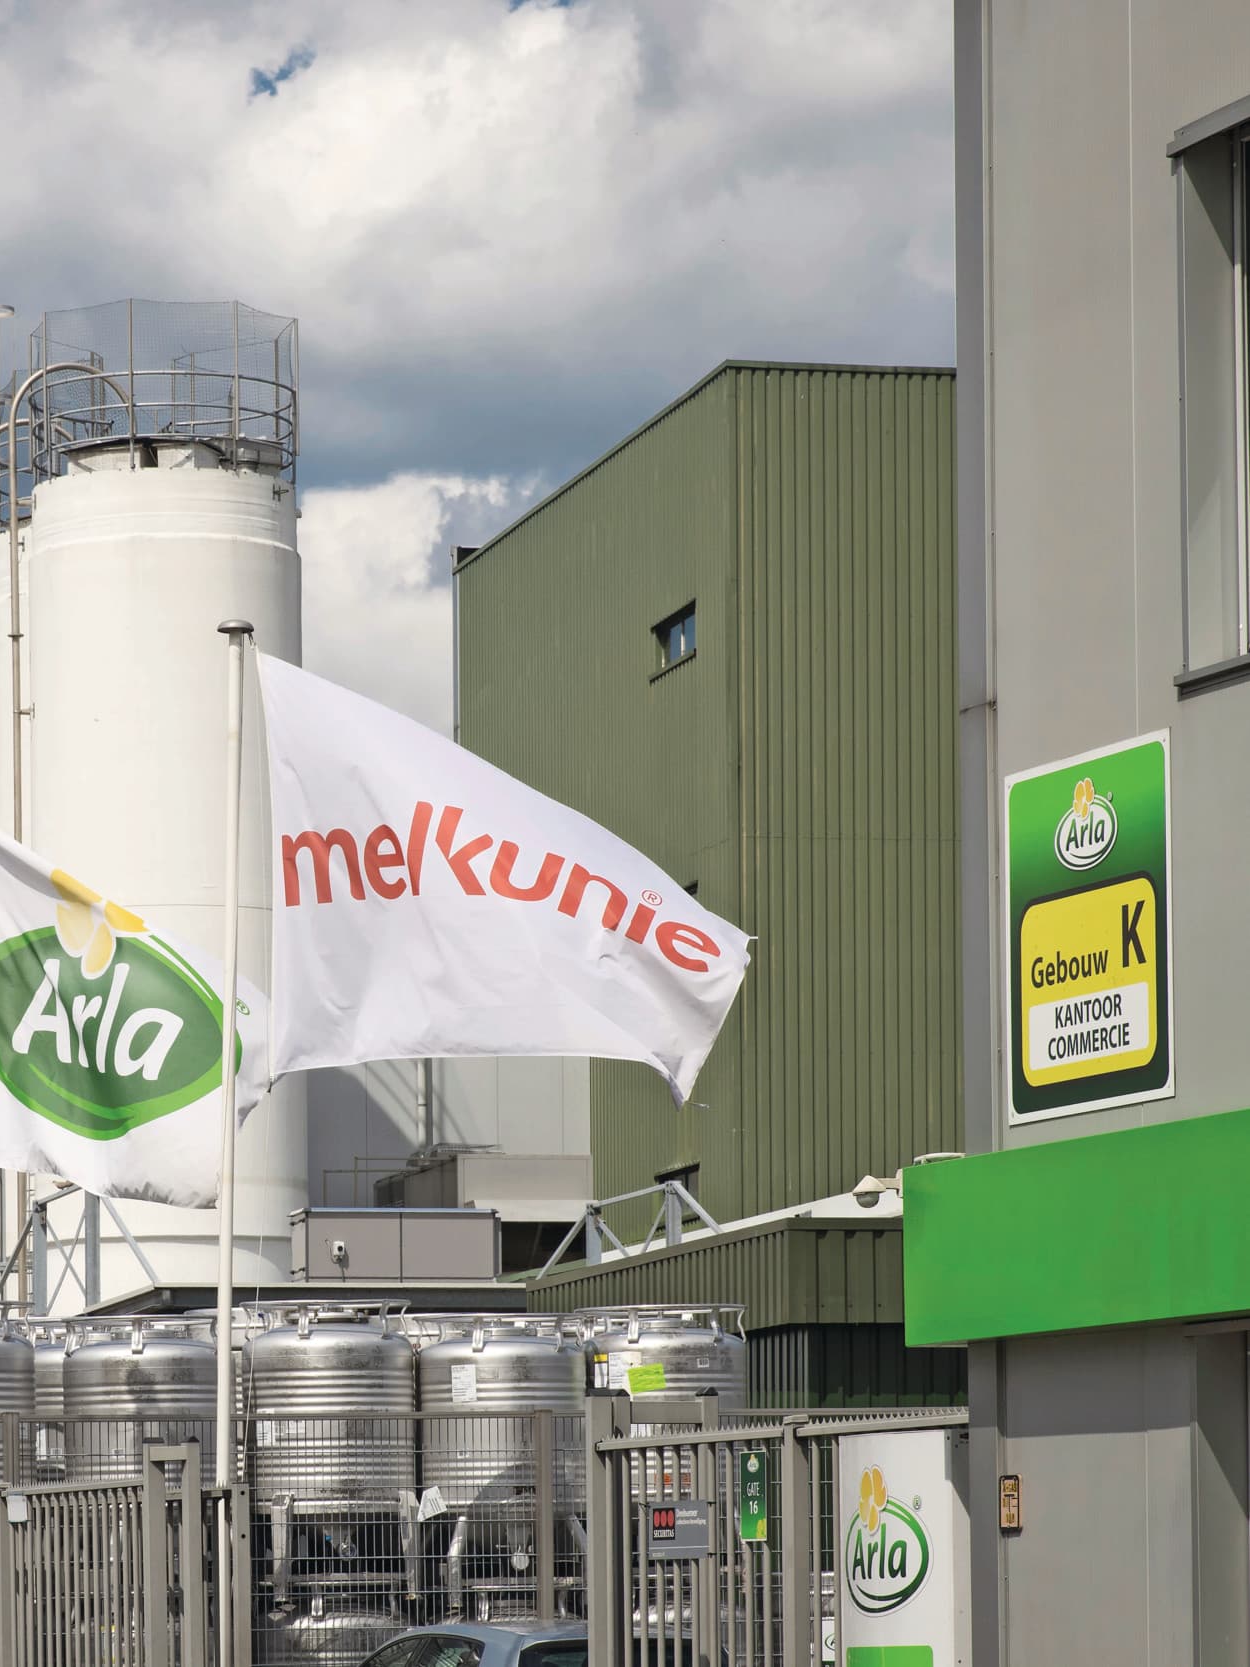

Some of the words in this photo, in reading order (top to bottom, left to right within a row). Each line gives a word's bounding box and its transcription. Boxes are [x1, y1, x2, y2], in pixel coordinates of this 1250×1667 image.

[1066, 810, 1105, 851] Arla
[282, 801, 721, 972] melkunie
[1031, 950, 1108, 989] Gebouw
[1121, 900, 1146, 968] K
[12, 958, 184, 1081] Arla
[1055, 994, 1122, 1029] KANTOOR
[1048, 1023, 1130, 1061] COMMERCIE
[746, 1482, 760, 1497] GATE
[749, 1500, 759, 1515] 16
[852, 1522, 907, 1581] Arla
